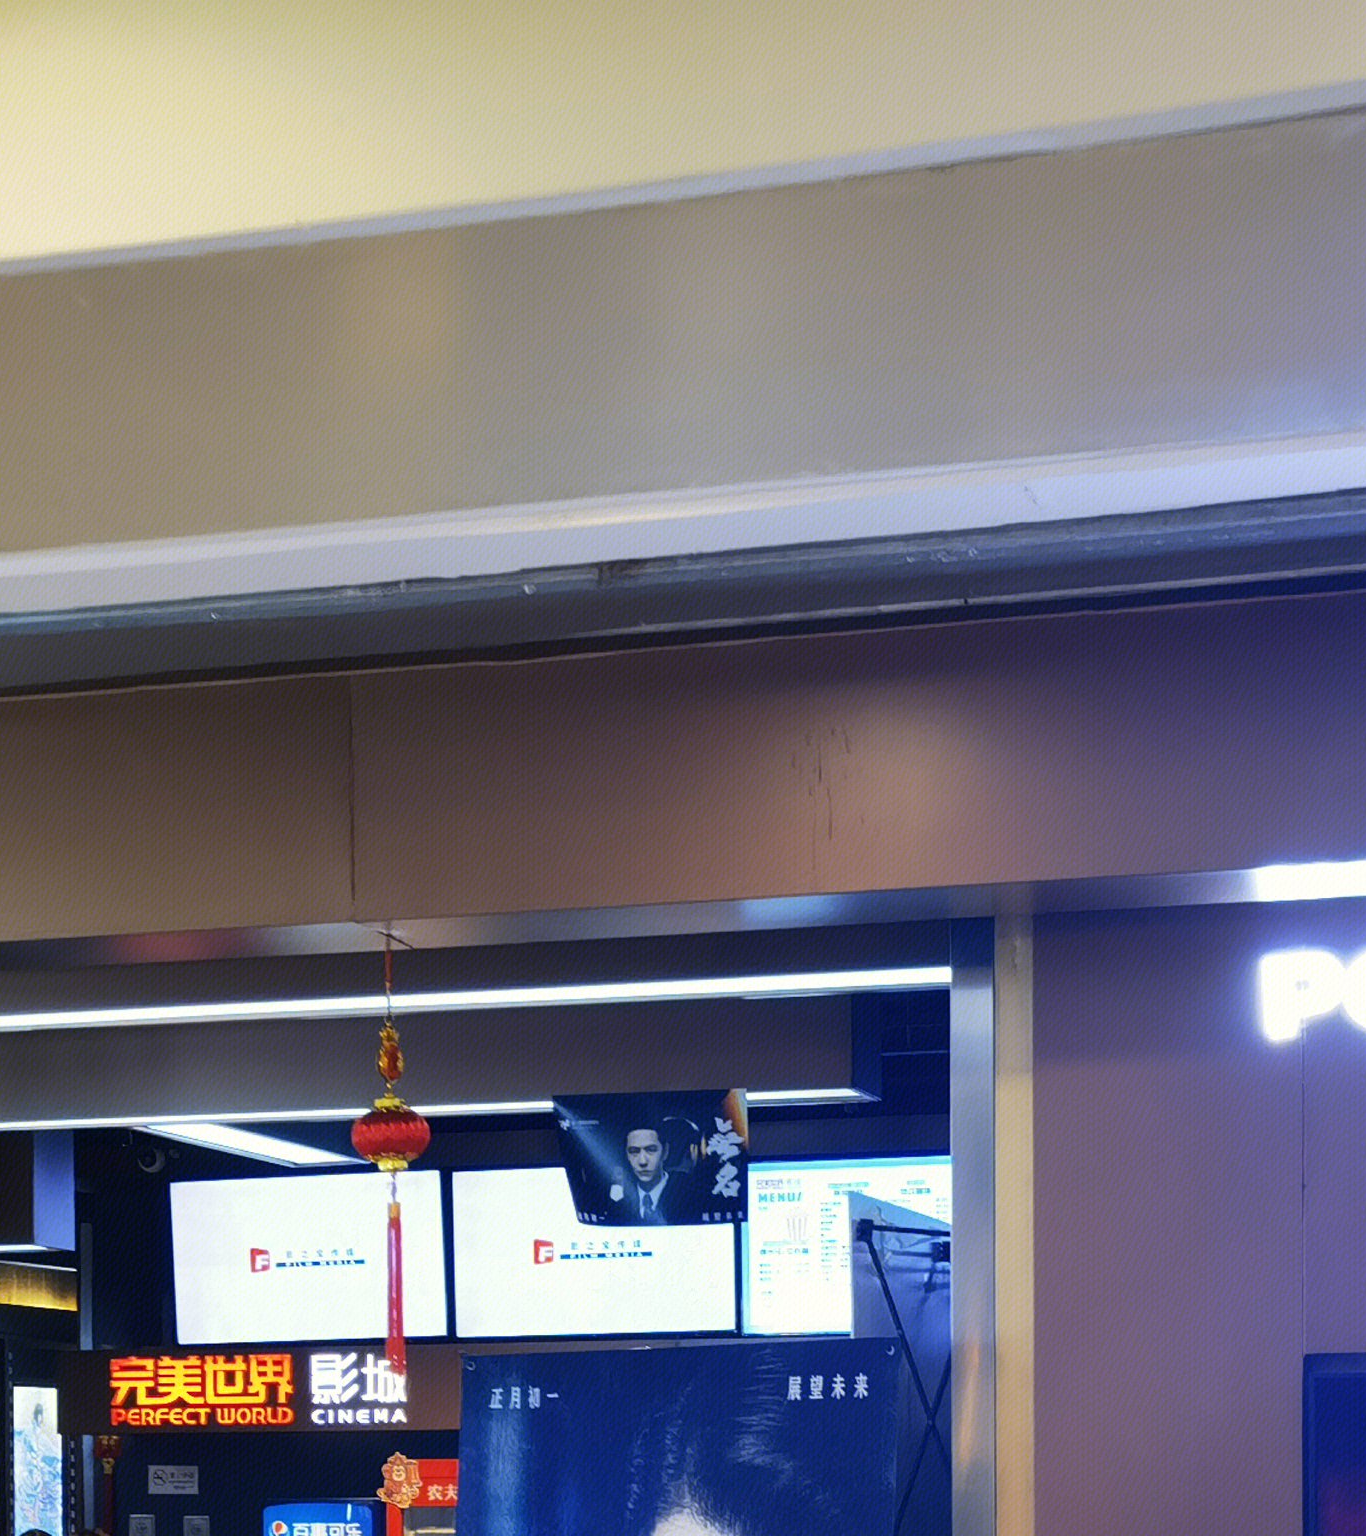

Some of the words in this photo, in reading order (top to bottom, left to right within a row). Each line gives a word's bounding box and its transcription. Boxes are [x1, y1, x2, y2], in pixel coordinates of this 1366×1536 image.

[109, 1352, 295, 1407] 完美世界
[308, 1351, 408, 1406] 影城
[785, 1372, 870, 1401] 展望未来
[487, 1385, 561, 1410] 正月初一
[110, 1407, 211, 1426] PERFECT
[216, 1406, 296, 1425] WORLD
[310, 1408, 408, 1425] CINEMA
